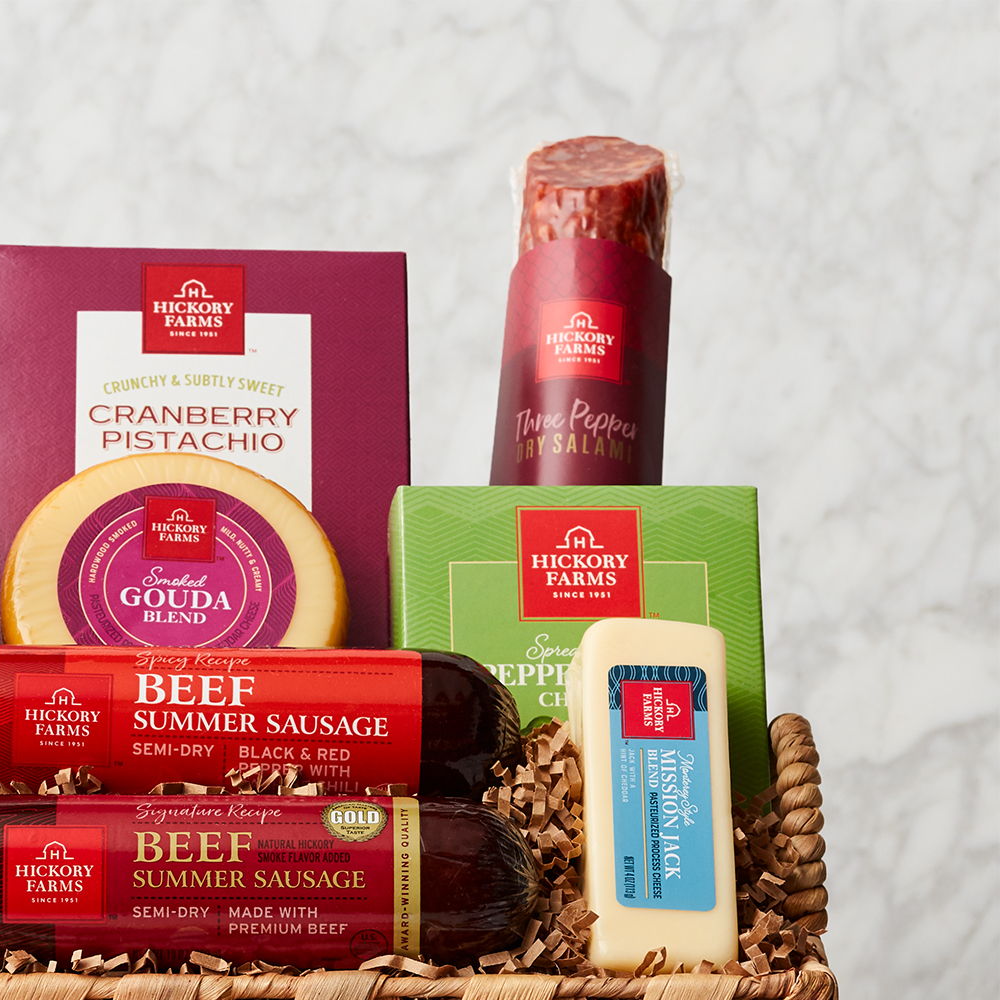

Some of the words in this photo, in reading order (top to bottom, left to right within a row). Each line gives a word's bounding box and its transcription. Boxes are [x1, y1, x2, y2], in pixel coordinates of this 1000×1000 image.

[153, 301, 234, 315] HICKORY
[164, 315, 223, 328] FARMS
[546, 331, 615, 345] HICKORY
[554, 343, 606, 356] FARMS
[103, 374, 167, 395] CRUNCHY
[171, 375, 181, 386] &
[185, 373, 235, 390] SUBTLY
[238, 378, 285, 398] SWEET
[88, 404, 299, 428] CRANBERRY
[516, 408, 565, 442] Three
[569, 398, 638, 440] Pepper
[102, 431, 285, 452] PISTACHIO
[516, 435, 546, 464] DRY
[553, 433, 632, 464] SALAMI
[151, 522, 207, 535] HICKORY
[159, 532, 200, 543] FARMS
[88, 541, 110, 583] HARDWOOD
[108, 520, 138, 543] SMOKED
[220, 525, 237, 542] MILD,
[236, 539, 253, 558] NUTTY
[251, 566, 262, 592] CREAMY
[531, 554, 629, 569] HICKORY
[142, 566, 206, 588] Smoked
[546, 571, 617, 586] FARMS
[120, 586, 231, 611] GOUDA
[90, 593, 123, 643] PASTEURIZED
[143, 611, 207, 624] BLEND
[240, 601, 260, 631] CHEESE
[135, 651, 188, 671] Spicy
[194, 652, 251, 672] Recipe
[134, 673, 255, 707] BEEF
[25, 709, 100, 723] HICKORY
[643, 693, 654, 727] FARMS
[653, 687, 664, 733] HICKORY
[35, 723, 90, 737] FARMS
[133, 710, 258, 734] SUMMER
[265, 714, 389, 737] SAUSAGE
[132, 742, 215, 758] SEMI-DRY
[238, 745, 295, 760] BLACK
[300, 747, 311, 760] &
[317, 748, 350, 761] RED
[310, 764, 350, 778] WITH
[620, 765, 627, 773] OF
[628, 766, 636, 782] WITH
[647, 749, 659, 788] BLEND
[677, 750, 694, 801] Monterey
[621, 774, 629, 803] CHEDDAR
[660, 749, 679, 830] MISSION
[135, 803, 222, 824] Signature
[224, 803, 283, 825] Recipe
[330, 810, 380, 824] GOLD
[649, 792, 660, 839] PASTEURIZED
[677, 794, 699, 827] Style
[400, 808, 409, 848] QUALITY
[133, 831, 253, 864] BEEF
[258, 839, 295, 851] NATURAL
[297, 839, 335, 851] HICKORY
[651, 839, 661, 871] PROCESS
[258, 851, 286, 864] SMOKE
[288, 851, 321, 864] FLAVOR
[322, 851, 351, 864] ADDED
[659, 832, 681, 880] JACK
[15, 864, 94, 879] HICKORY
[132, 870, 246, 889] SUMMER
[254, 869, 366, 889] SAUSAGE
[26, 879, 83, 893] FARMS
[652, 872, 662, 899] CHEESE
[132, 906, 210, 918] SEMI-DRY
[228, 906, 273, 918] MADE
[279, 906, 318, 918] WITH
[401, 852, 410, 951] AWARD-WINNING
[228, 923, 302, 935] PREMIUM
[308, 923, 349, 935] BEEF
